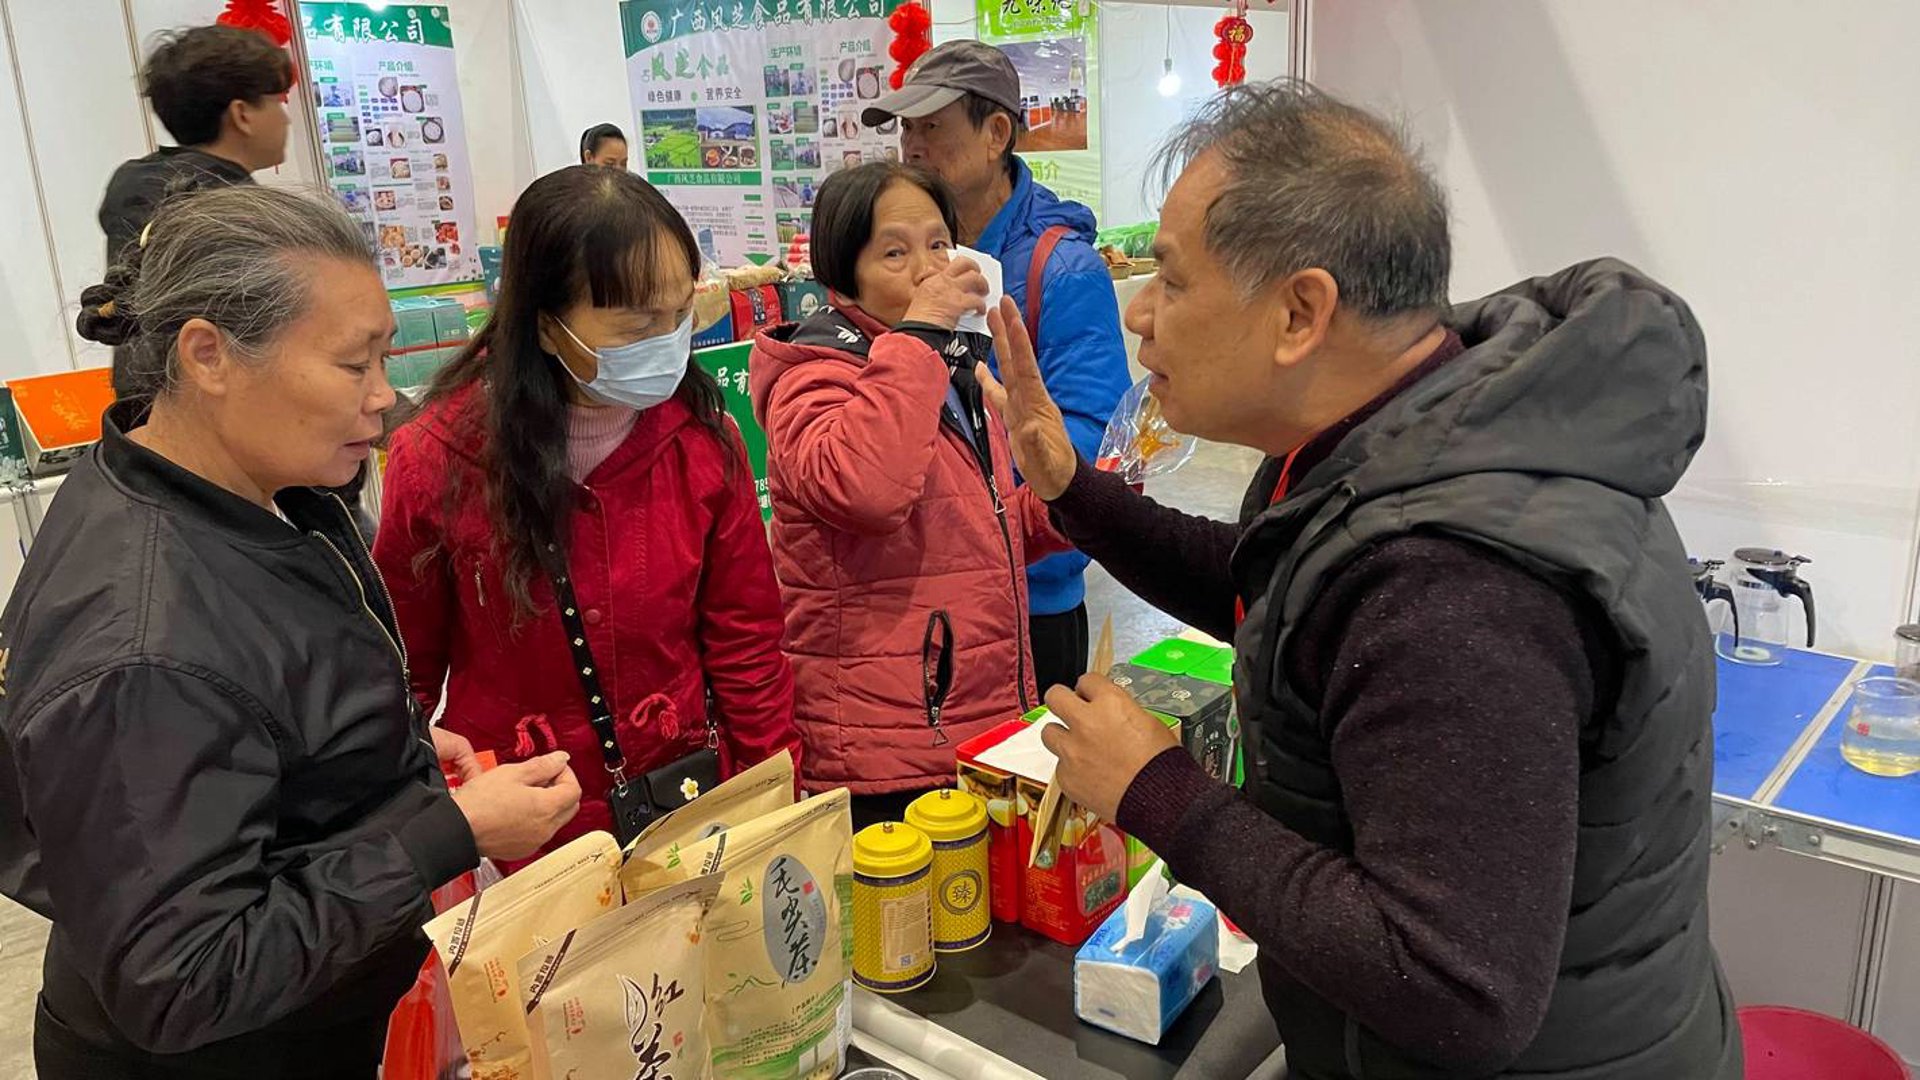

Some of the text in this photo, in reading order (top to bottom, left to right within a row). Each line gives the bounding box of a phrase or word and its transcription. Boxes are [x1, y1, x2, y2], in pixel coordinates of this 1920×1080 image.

[1228, 25, 1246, 43] 福
[705, 86, 742, 101] 营养安全
[717, 366, 750, 396] 品有
